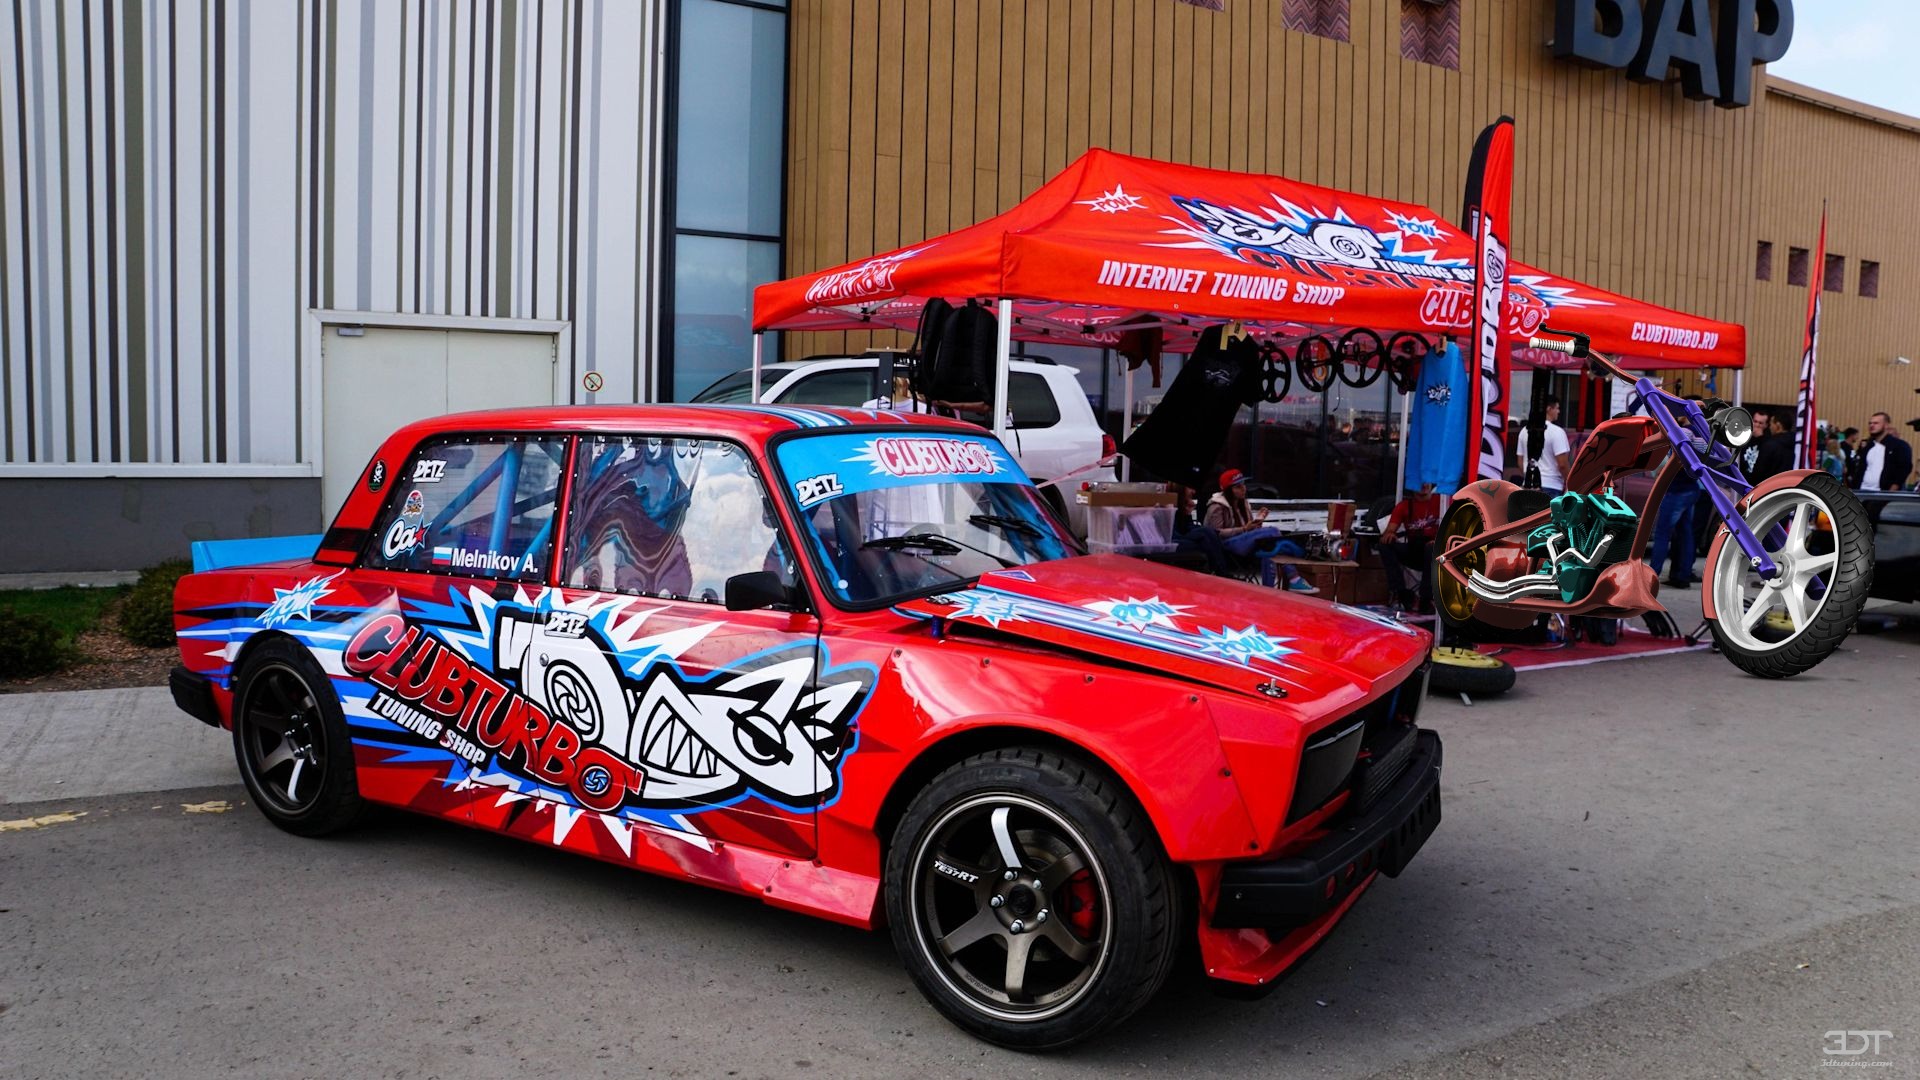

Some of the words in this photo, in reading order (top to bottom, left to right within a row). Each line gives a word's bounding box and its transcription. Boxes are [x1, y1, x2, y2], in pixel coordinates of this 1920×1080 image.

[1097, 260, 1207, 294] INTERNET
[1210, 272, 1288, 301] TUNING
[1292, 281, 1345, 306] SHOP
[1374, 257, 1452, 280] TUNING
[1420, 287, 1550, 338] CLUBBO
[1631, 321, 1719, 350] CLUBTURBO.RU
[876, 438, 995, 476] CLUBTURBO
[452, 548, 520, 572] Melnikov
[521, 553, 539, 573] A.
[344, 612, 645, 812] CLUBTURBO
[371, 692, 442, 740] TUNING
[439, 728, 487, 765] SHOP
